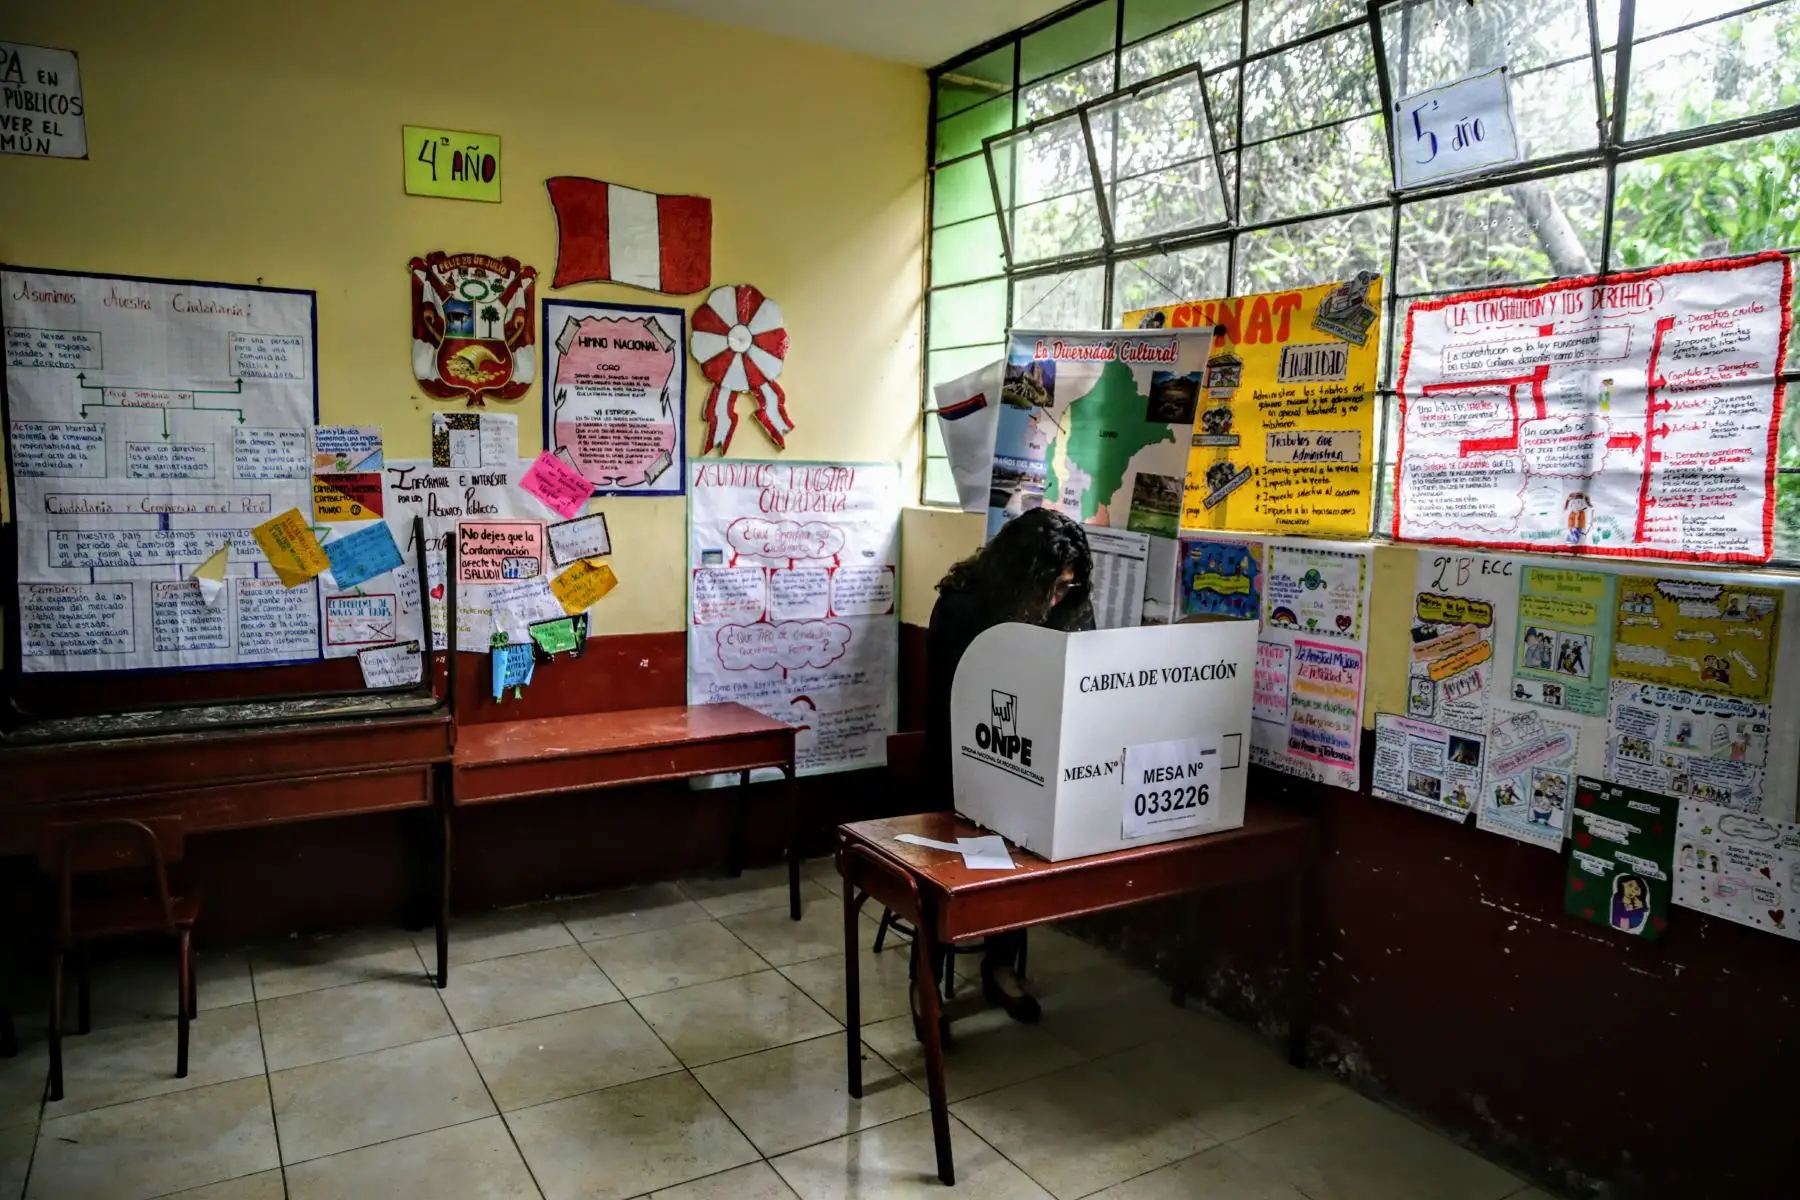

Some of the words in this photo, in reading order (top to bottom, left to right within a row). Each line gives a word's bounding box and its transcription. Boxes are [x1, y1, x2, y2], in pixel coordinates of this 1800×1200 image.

[37, 69, 58, 87] EN
[3, 83, 84, 117] PÚBLICOS
[43, 121, 63, 137] EL
[452, 145, 496, 183] AÑO
[486, 259, 507, 275] JULIO
[13, 280, 76, 305] Asumimos
[1454, 307, 1470, 327] LA
[1549, 295, 1557, 315] Y
[1591, 282, 1655, 311] DERECHOS
[1171, 293, 1303, 347] SUNAT
[613, 338, 659, 352] NACIONAL
[1033, 339, 1049, 361] La
[1053, 340, 1117, 362] Diversidad
[1119, 339, 1179, 364] Cultural
[459, 475, 466, 487] E
[461, 528, 479, 540] No
[480, 528, 506, 544] dejes
[507, 532, 523, 545] que
[525, 530, 534, 541] la
[460, 541, 530, 556] Contaminación
[491, 558, 501, 568] tu
[1079, 671, 1135, 693] CABINA
[1138, 669, 1158, 688] DE
[1161, 659, 1238, 685] VOTACIÓN
[975, 722, 1033, 767] ONPE
[1064, 764, 1101, 782] MESA
[1143, 766, 1185, 785] MESA
[1134, 783, 1210, 817] 033226
